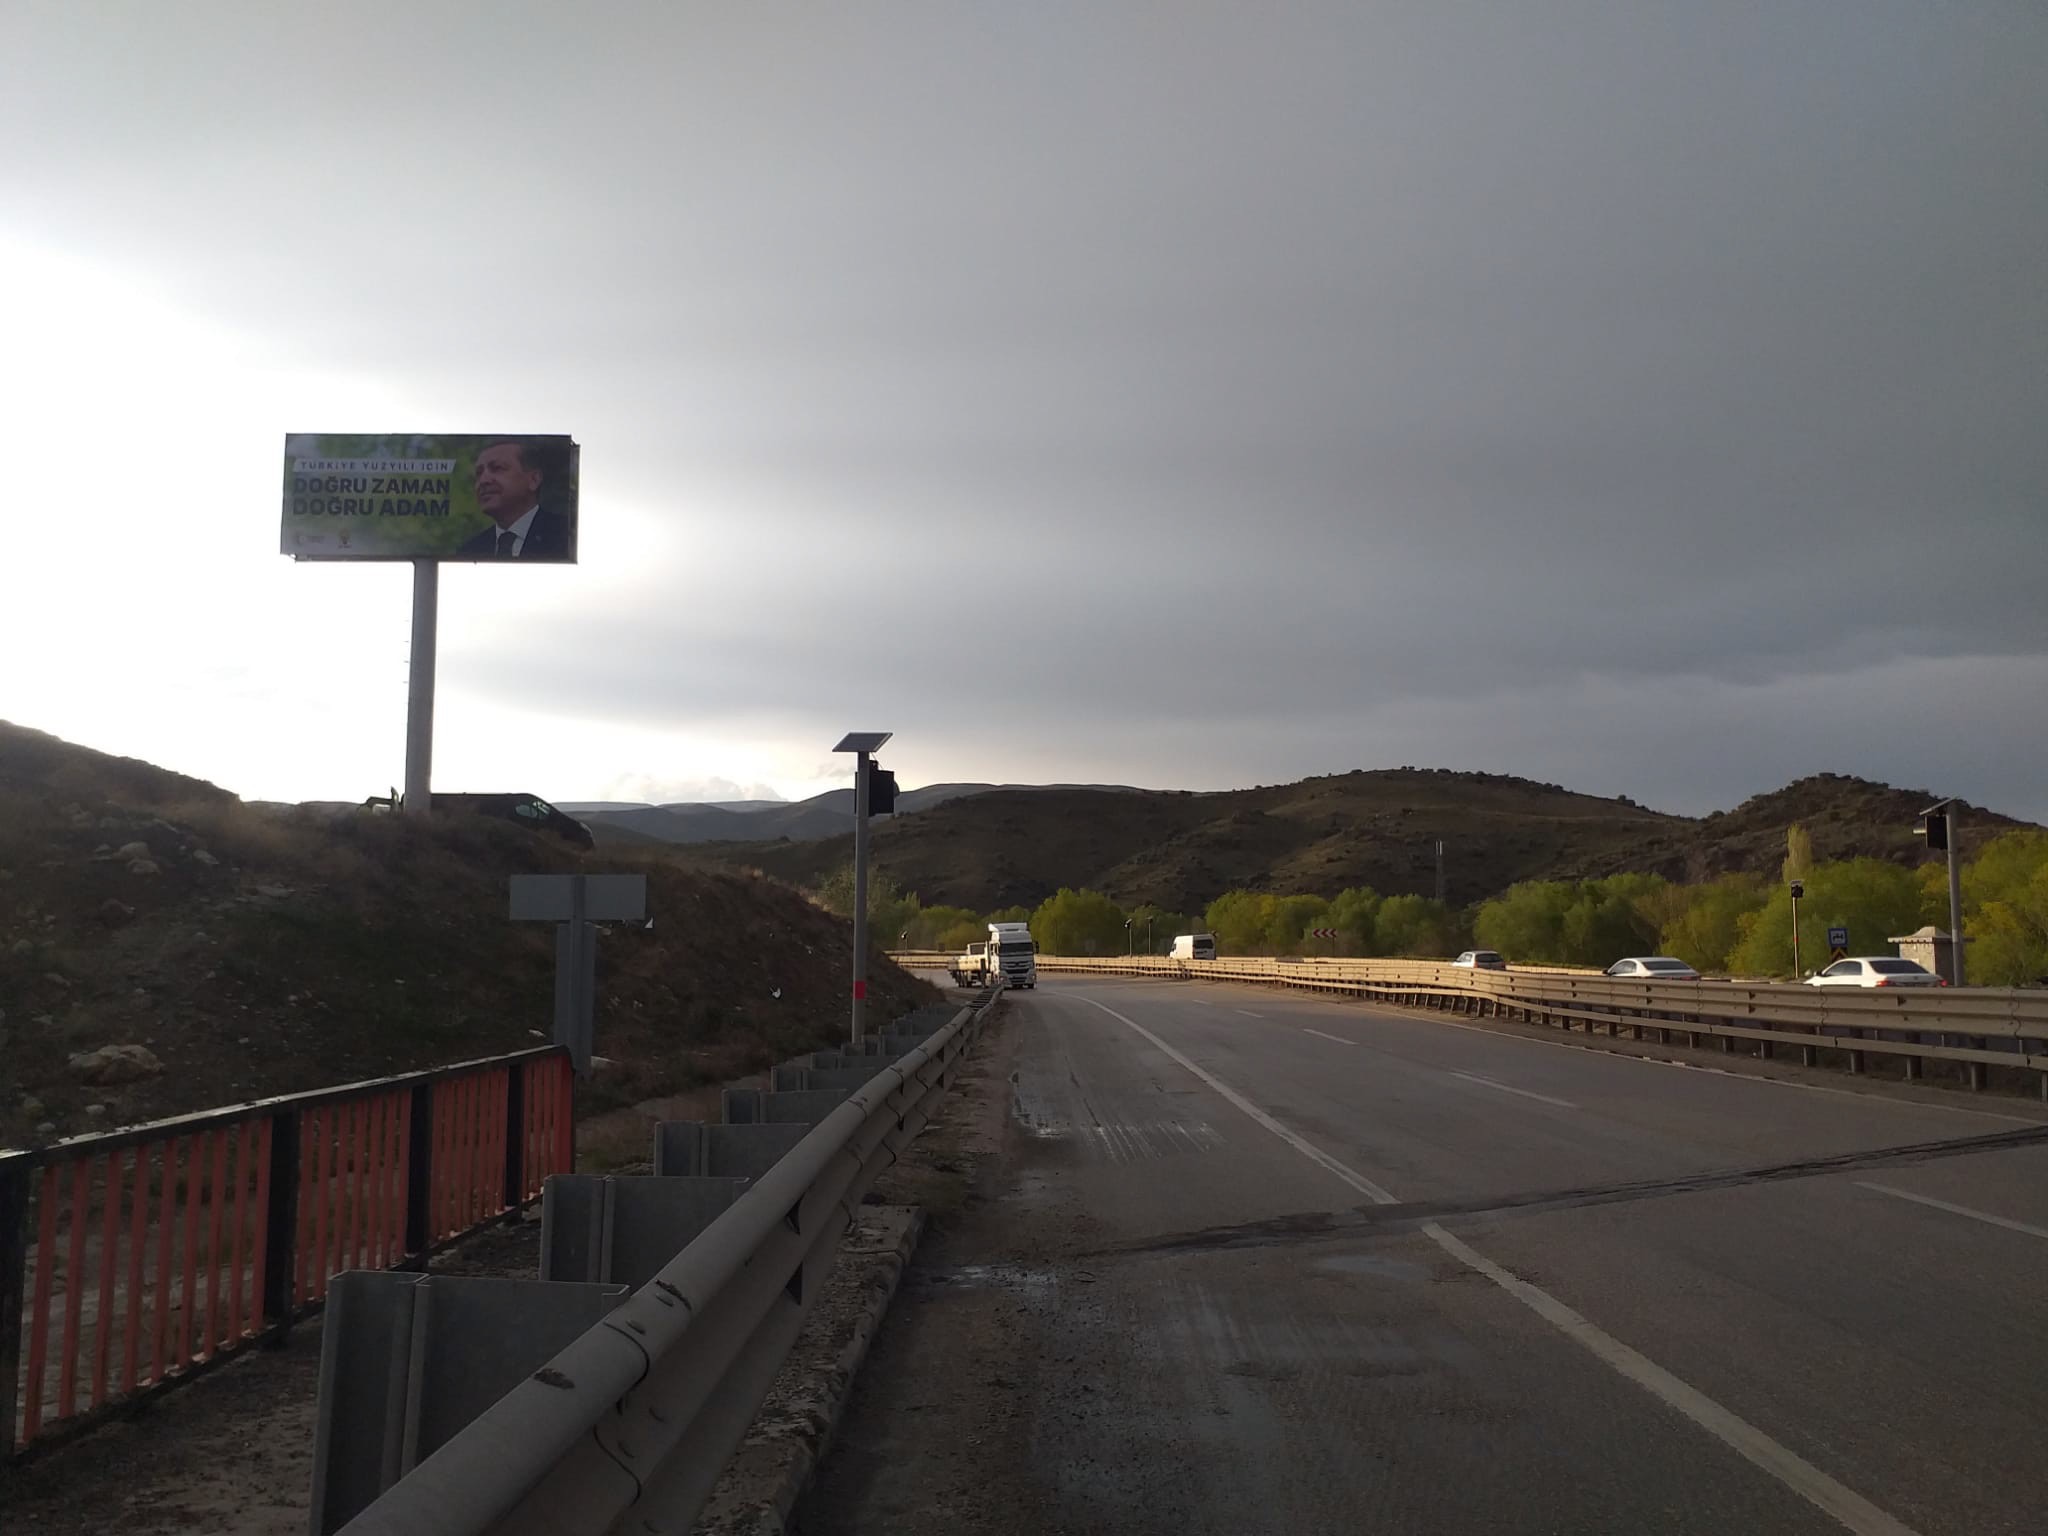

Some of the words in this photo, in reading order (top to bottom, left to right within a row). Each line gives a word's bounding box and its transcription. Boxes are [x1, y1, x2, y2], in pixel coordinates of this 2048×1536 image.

[294, 476, 367, 494] DOĞRU
[373, 479, 450, 494] ZAMAN
[292, 496, 373, 515] DOĞRU
[379, 500, 450, 516] ADAM
